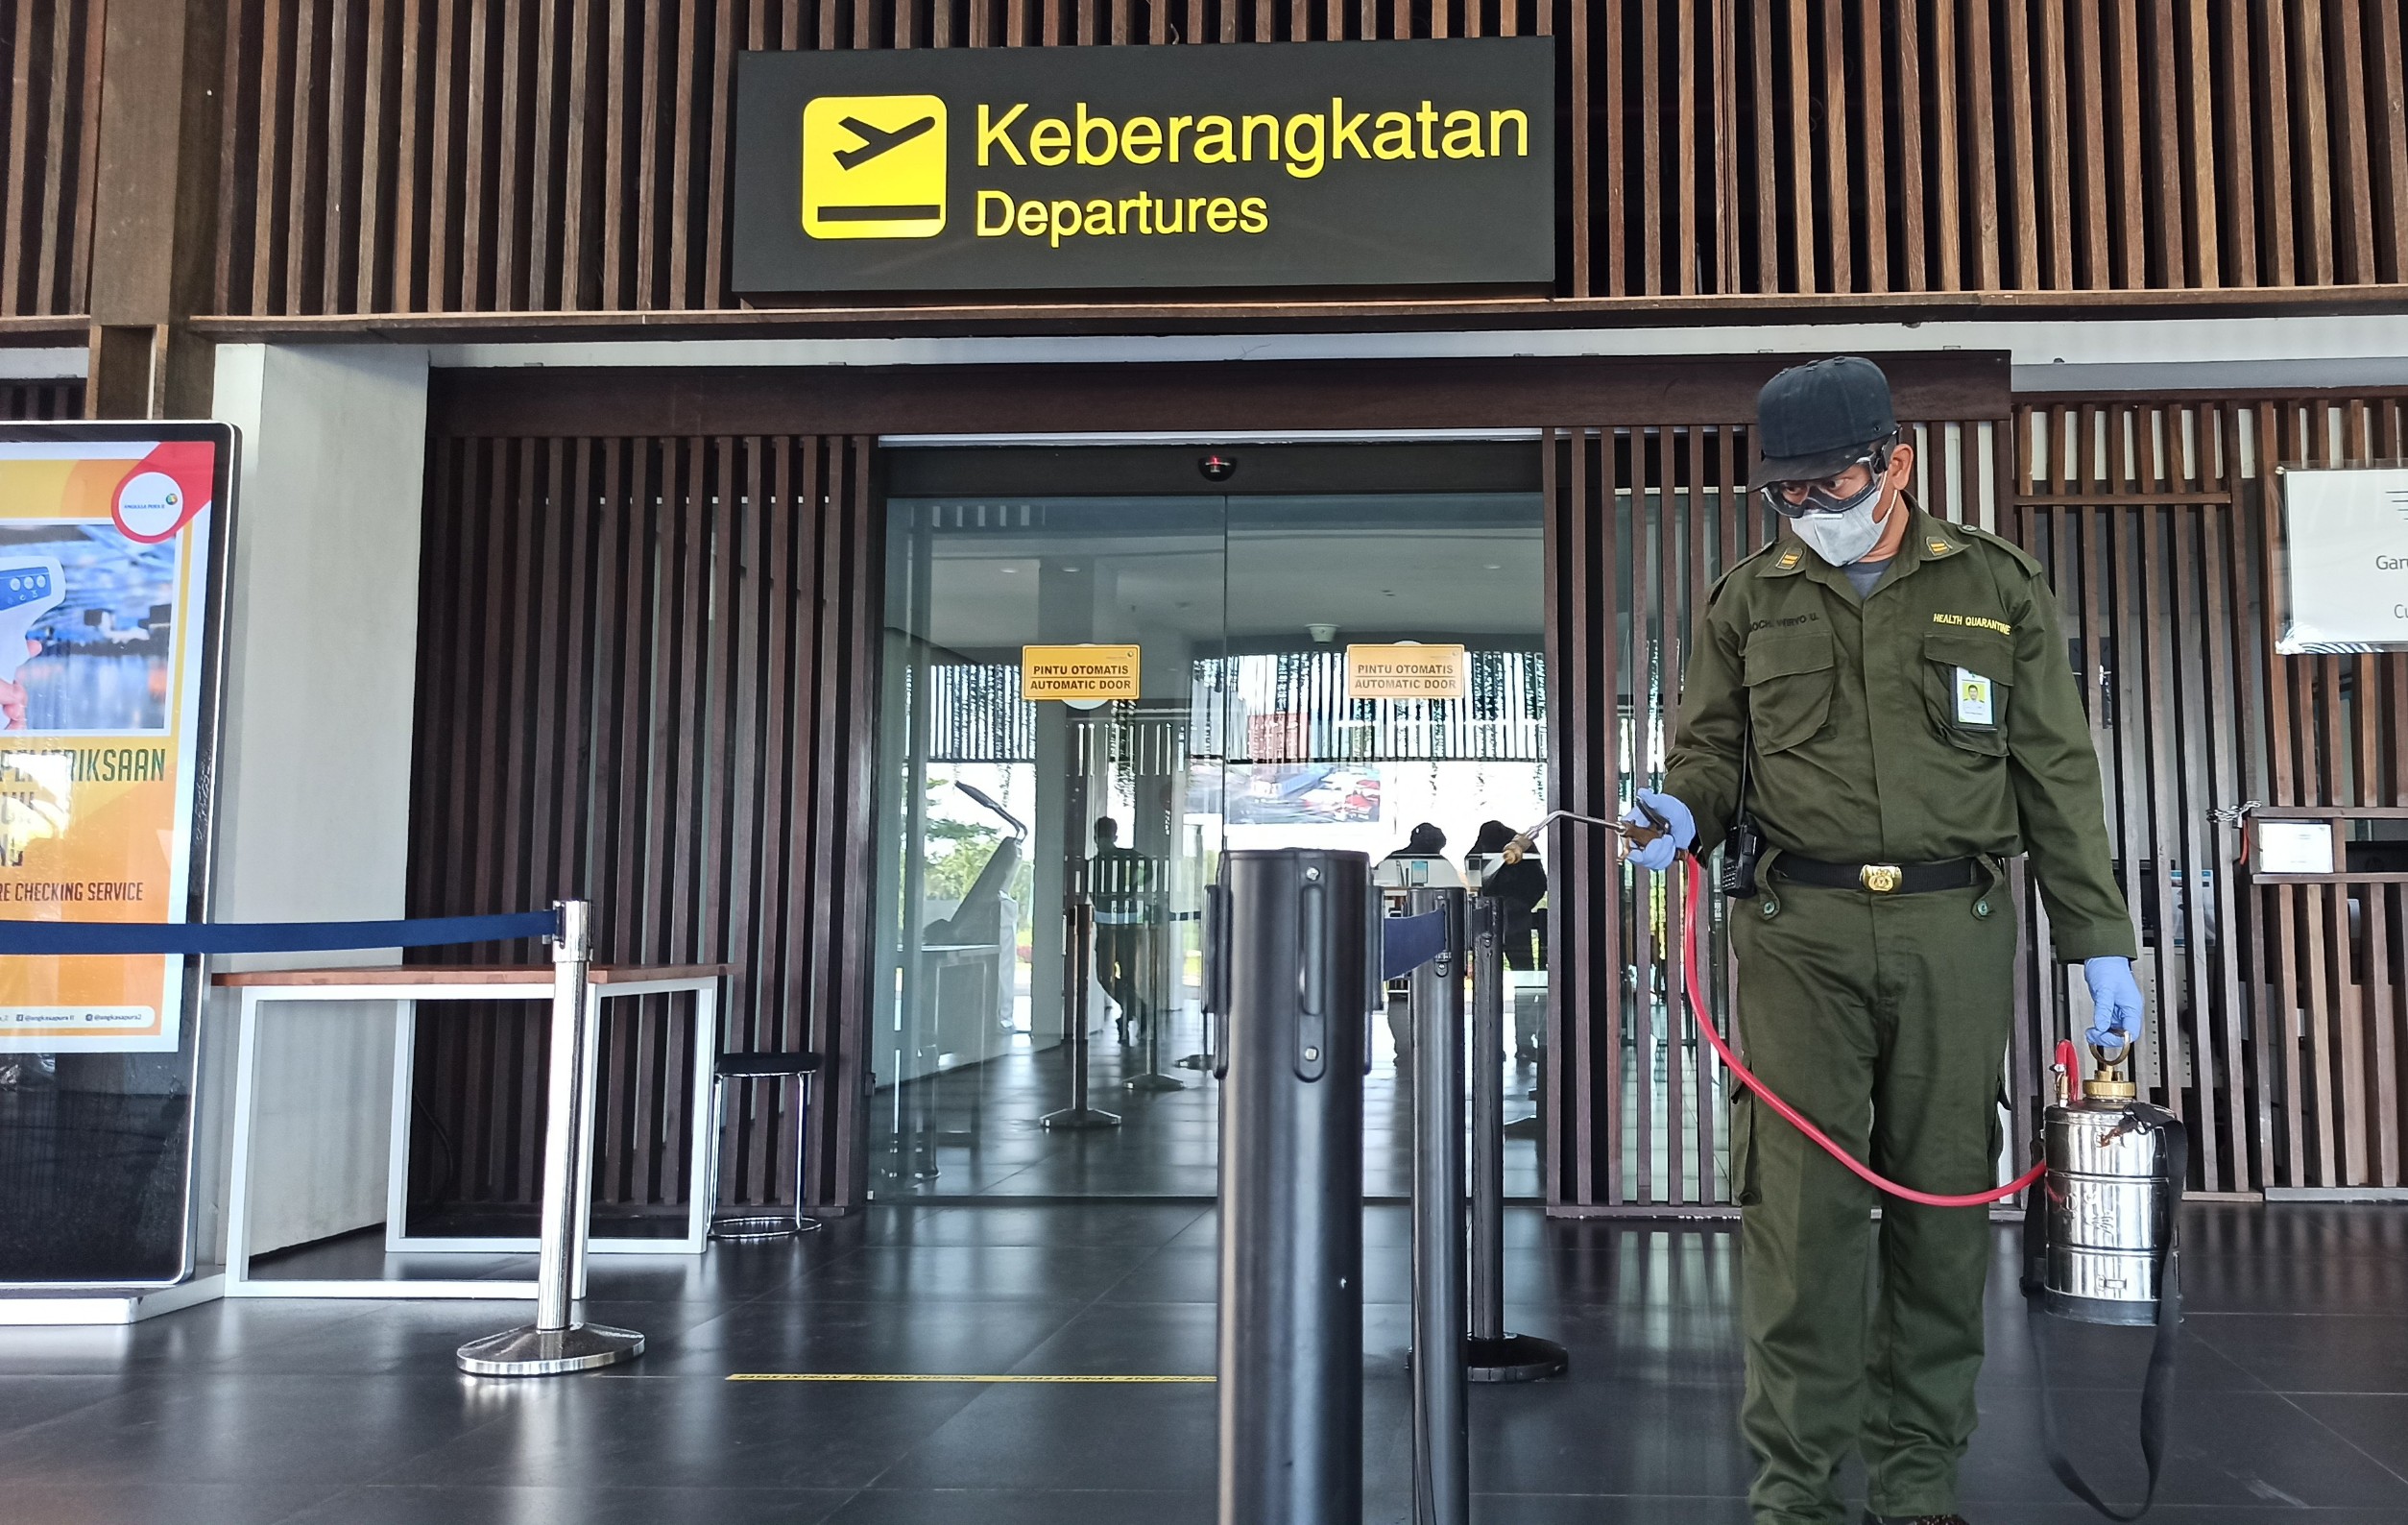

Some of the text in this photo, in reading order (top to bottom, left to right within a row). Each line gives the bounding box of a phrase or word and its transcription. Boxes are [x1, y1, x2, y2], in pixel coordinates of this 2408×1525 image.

[977, 97, 1529, 179] Keberangkatan
[977, 190, 1268, 248] Departures
[1933, 613, 2011, 636] HEALTH QUARANTINE
[1033, 665, 1129, 675] PINTU OTOMATIS
[1358, 665, 1454, 674] PINTU OTOMATIS
[1030, 680, 1131, 690] AUTOMATIC DOOR
[1355, 679, 1457, 689] AUTOMATIC DOOR
[15, 882, 84, 901] CHECKING
[87, 882, 143, 901] SERVICE
